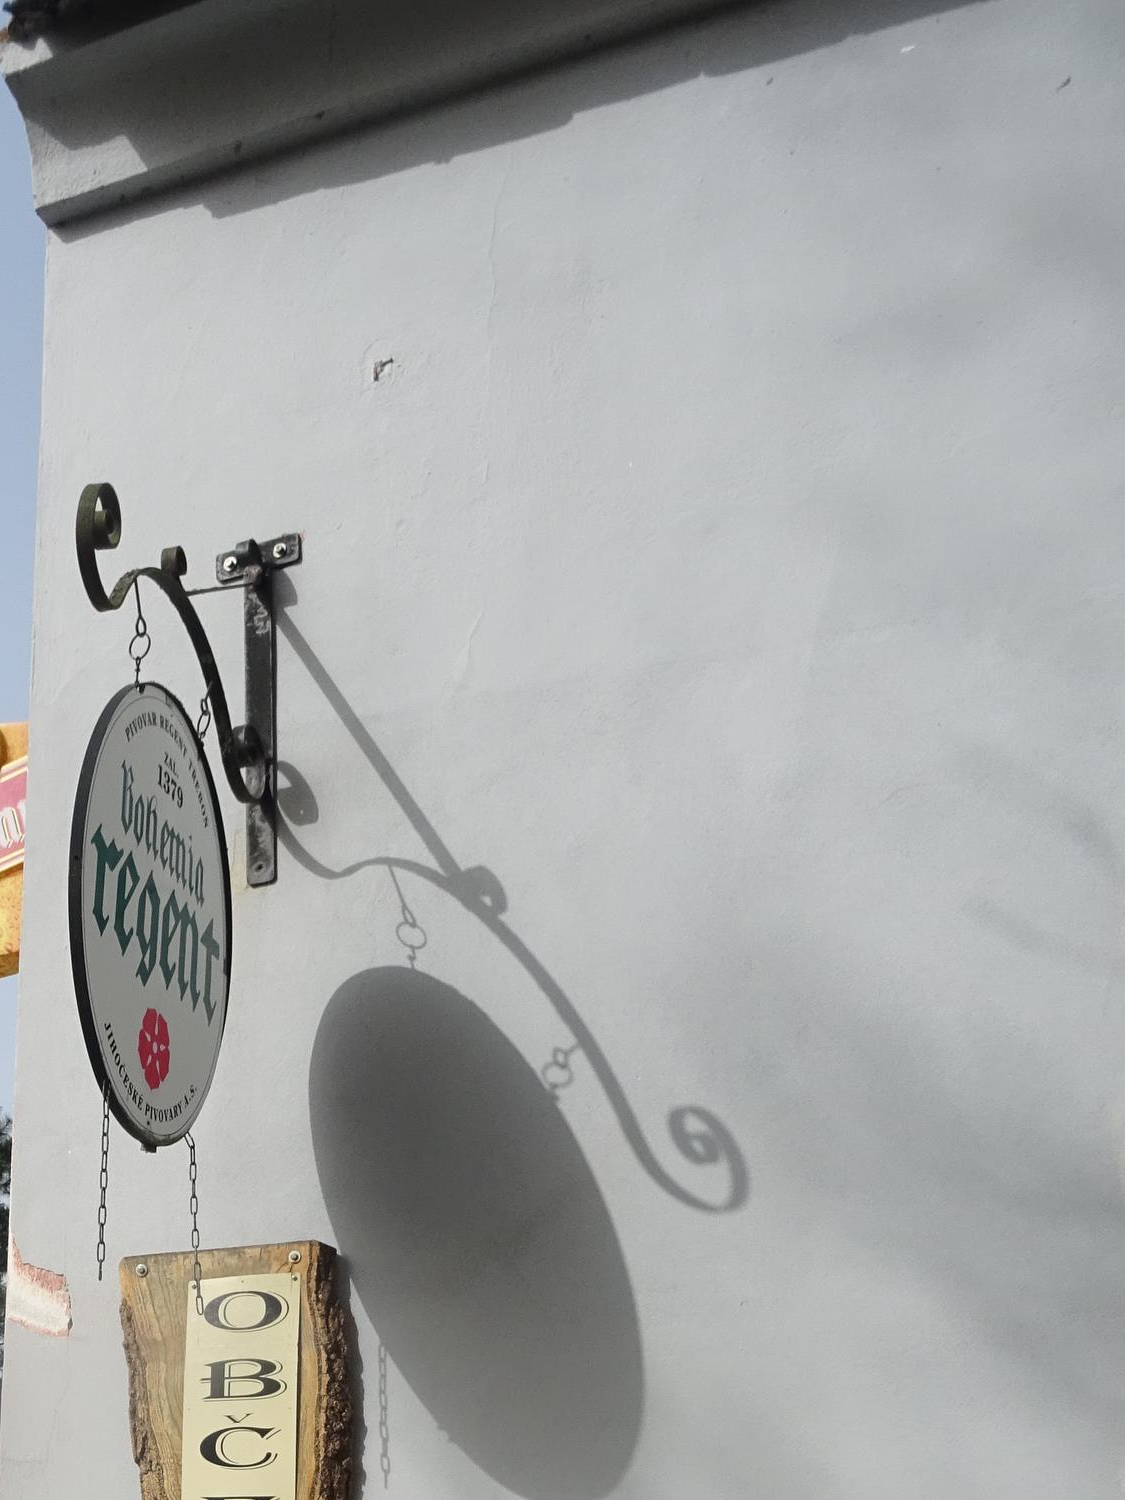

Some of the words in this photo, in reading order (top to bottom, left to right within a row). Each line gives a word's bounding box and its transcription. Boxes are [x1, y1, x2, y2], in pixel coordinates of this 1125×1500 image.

[125, 712, 157, 742] PIVOVAR
[160, 715, 187, 757] REGENT
[121, 760, 205, 908] Bohemia
[158, 764, 183, 808] 1379
[90, 823, 220, 1028] regent
[104, 1022, 144, 1111] JIHOČESKÉ
[144, 1100, 183, 1123] PIVOVARY
[184, 1084, 197, 1109] A.S.
